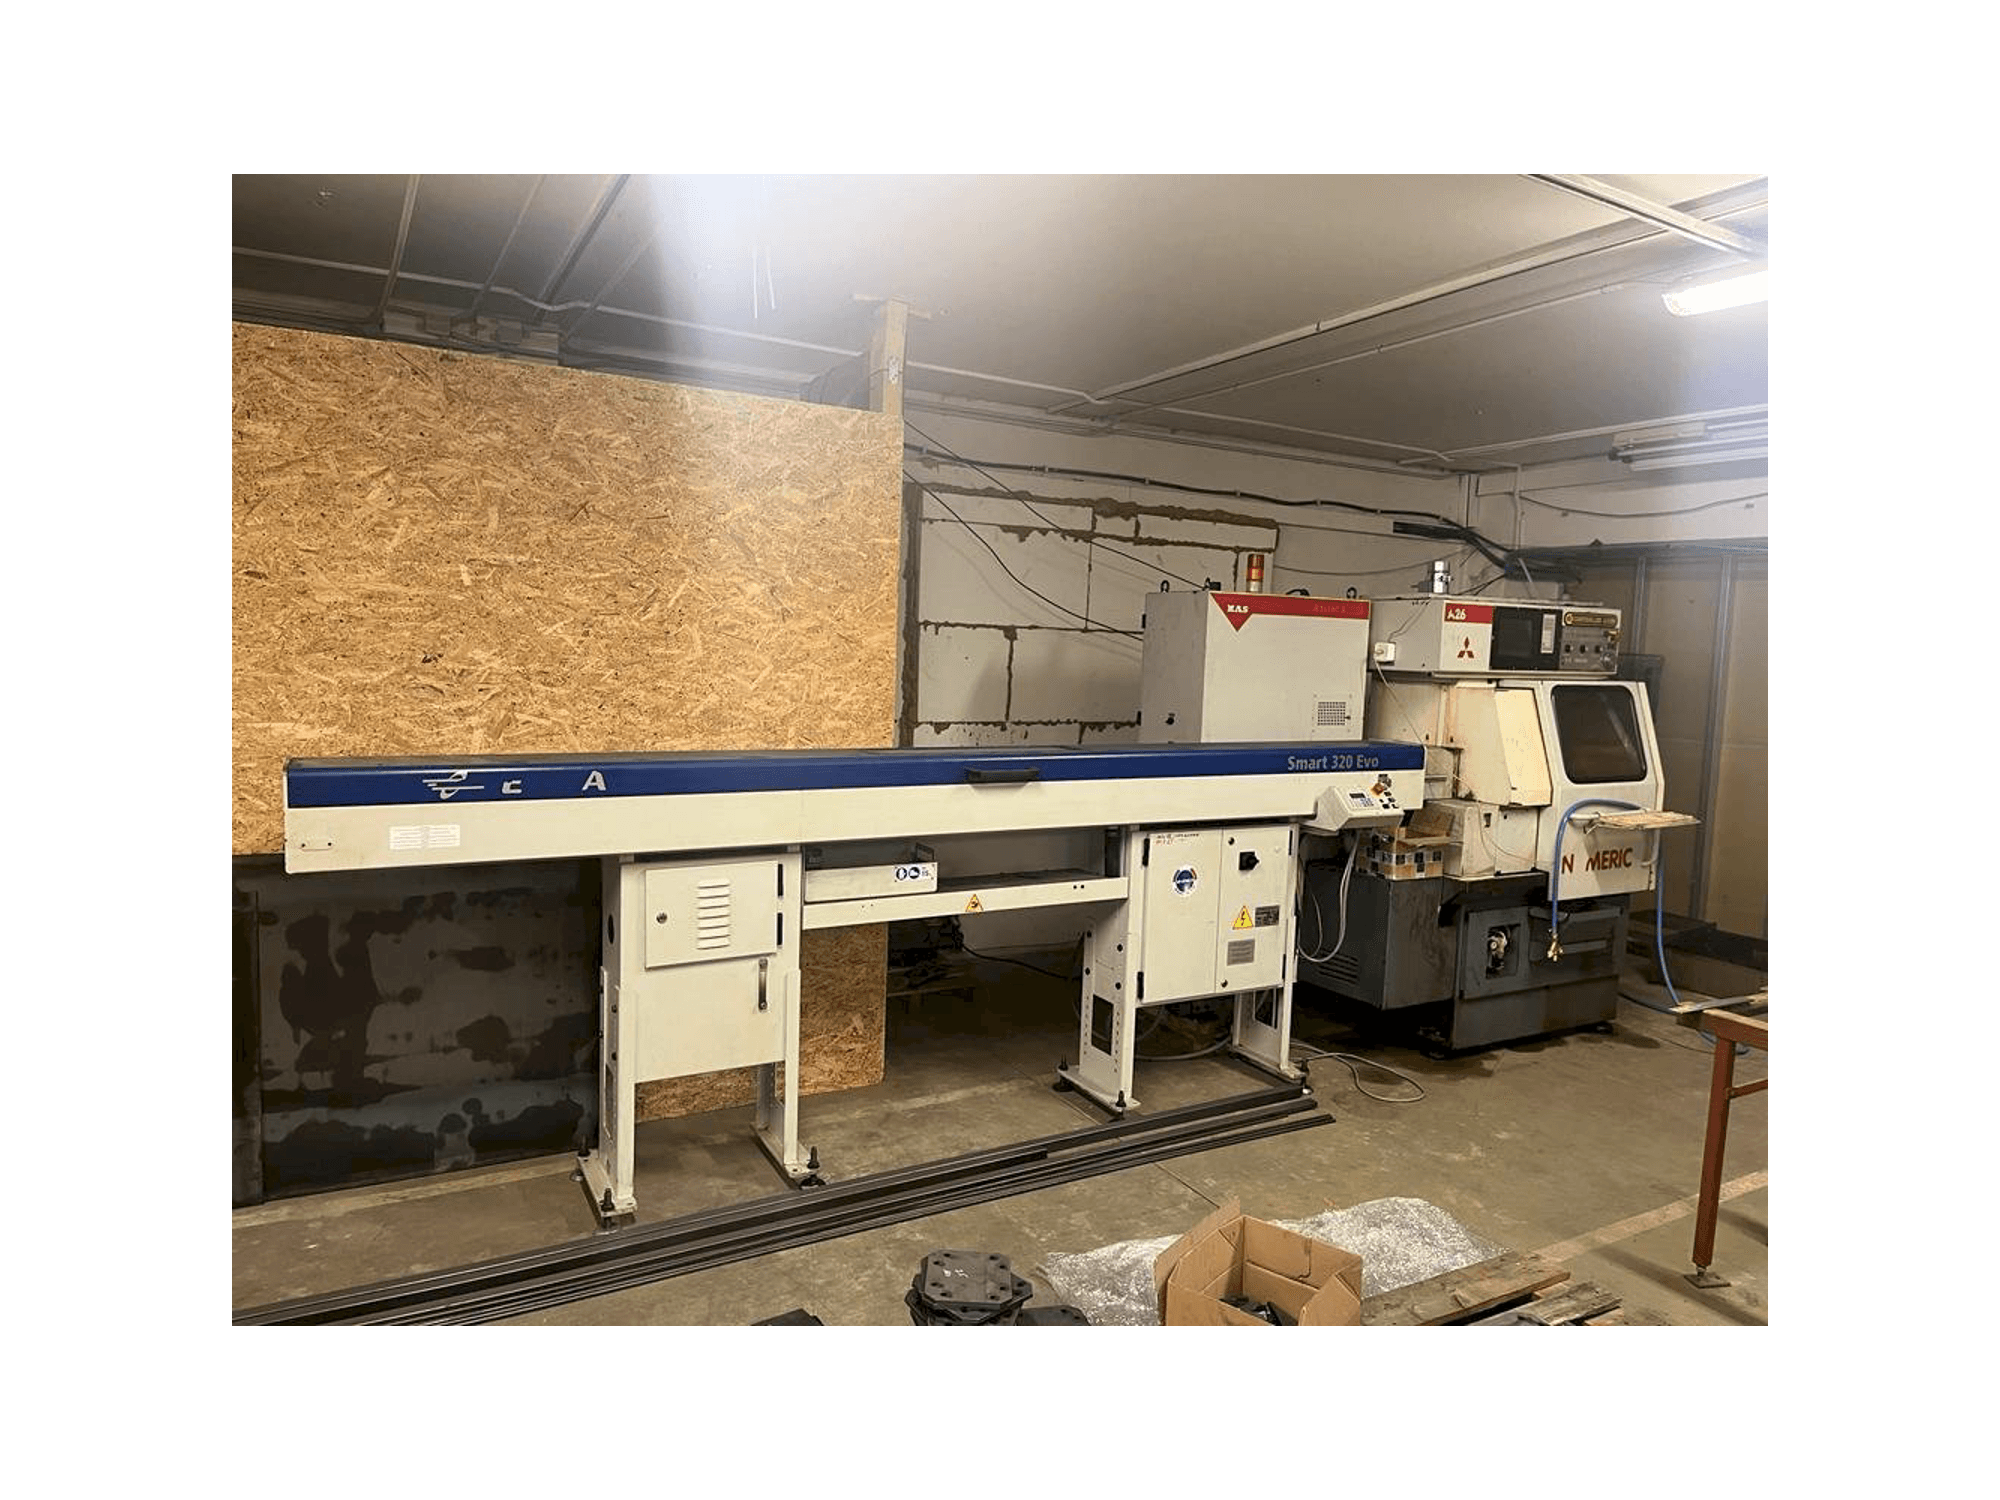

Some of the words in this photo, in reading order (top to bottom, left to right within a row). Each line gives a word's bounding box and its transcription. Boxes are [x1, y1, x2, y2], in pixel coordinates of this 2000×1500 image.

[1287, 755, 1328, 770] Smart
[1331, 755, 1353, 769] 320
[1356, 755, 1379, 768] Evo
